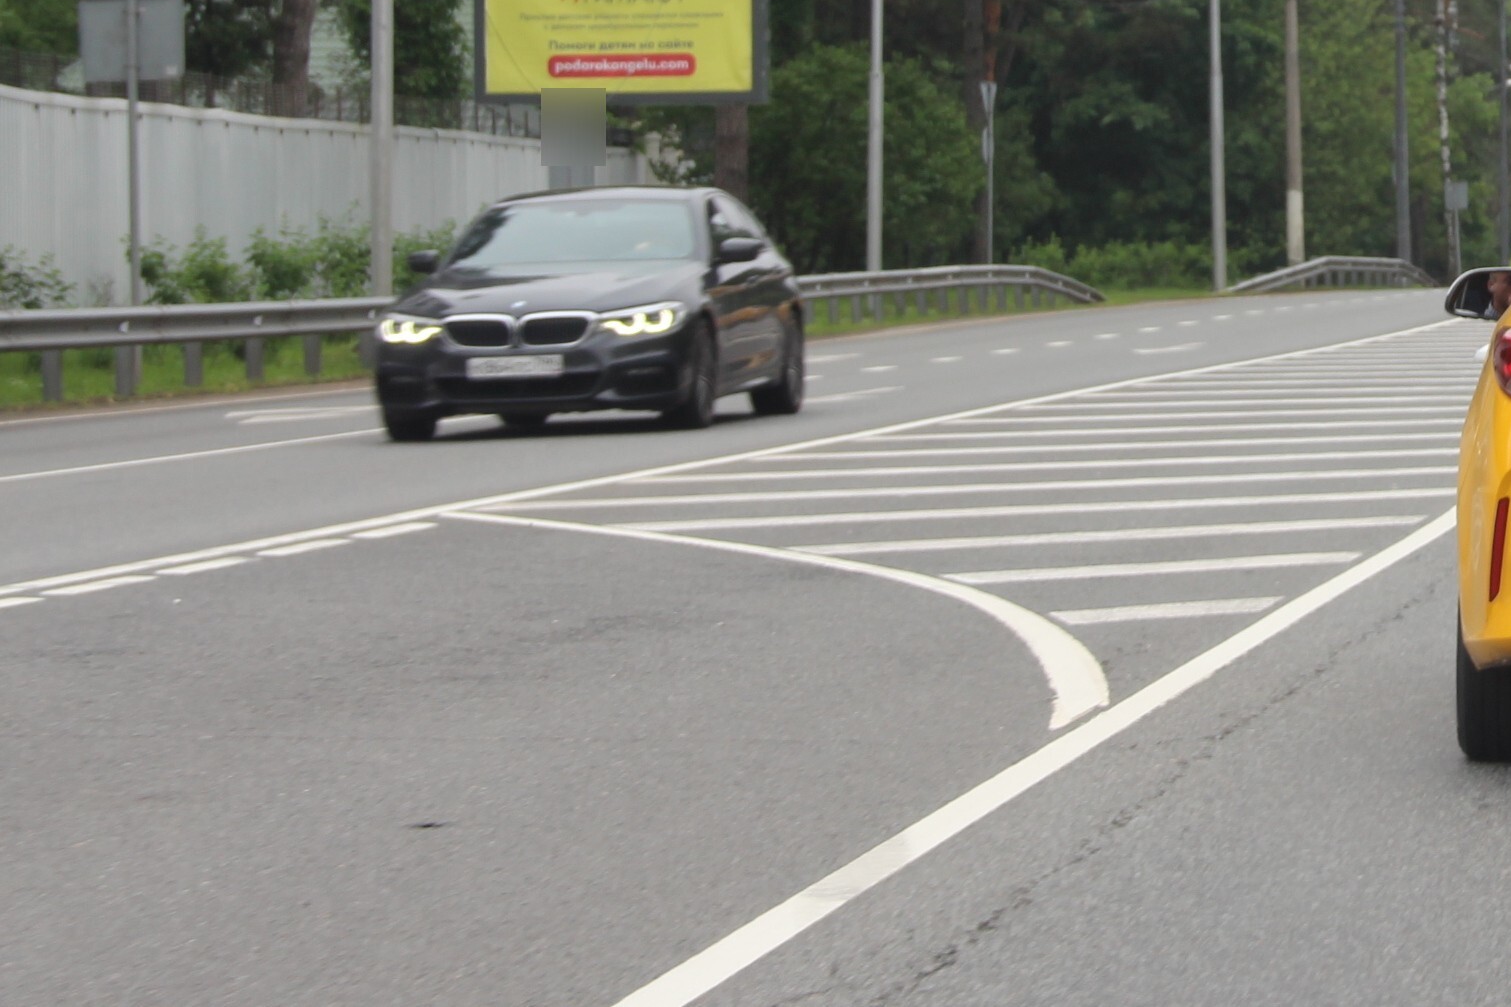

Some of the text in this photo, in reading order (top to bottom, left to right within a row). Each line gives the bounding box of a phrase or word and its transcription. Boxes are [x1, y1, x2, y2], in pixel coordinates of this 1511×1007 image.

[549, 39, 694, 51] Помоги детям на сайте
[554, 58, 690, 74] podarokangelu.com
